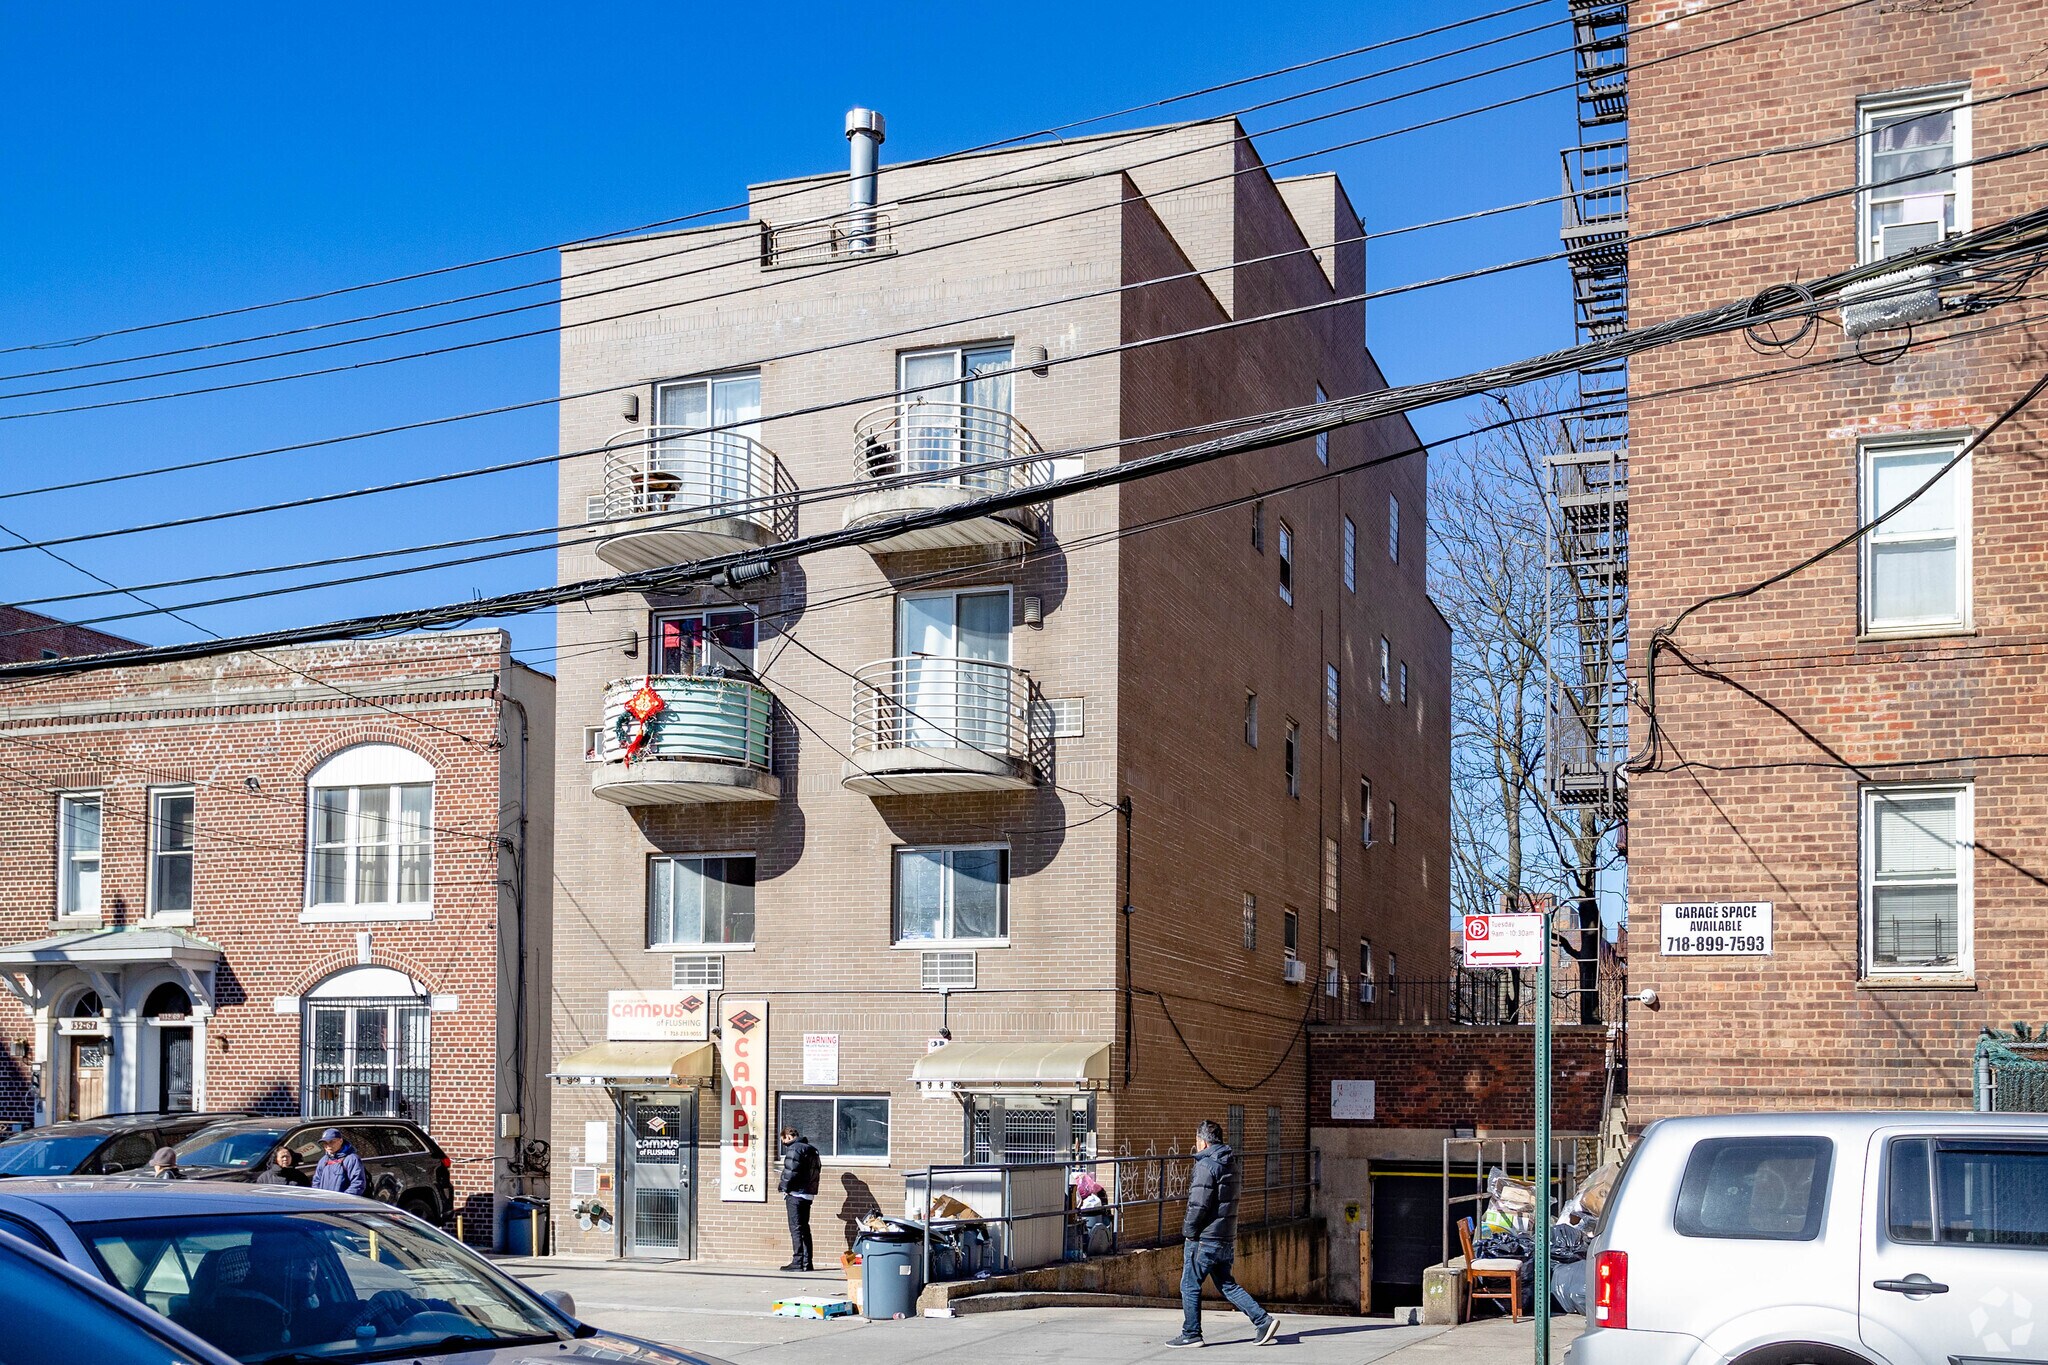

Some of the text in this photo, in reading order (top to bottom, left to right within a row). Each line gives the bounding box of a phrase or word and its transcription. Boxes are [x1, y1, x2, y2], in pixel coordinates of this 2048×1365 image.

[1675, 905, 1757, 919] GARAGE SPACE
[1690, 920, 1742, 932] AVAILABLE
[1667, 936, 1764, 952] 718-899-7593
[612, 1003, 684, 1018] CAMPUS
[656, 1019, 701, 1027] of FLUSHING
[806, 1036, 837, 1044] WARNING
[730, 1037, 757, 1178] CAMPUS
[635, 1139, 680, 1149] CAMPUS
[738, 1184, 755, 1193] CEA
